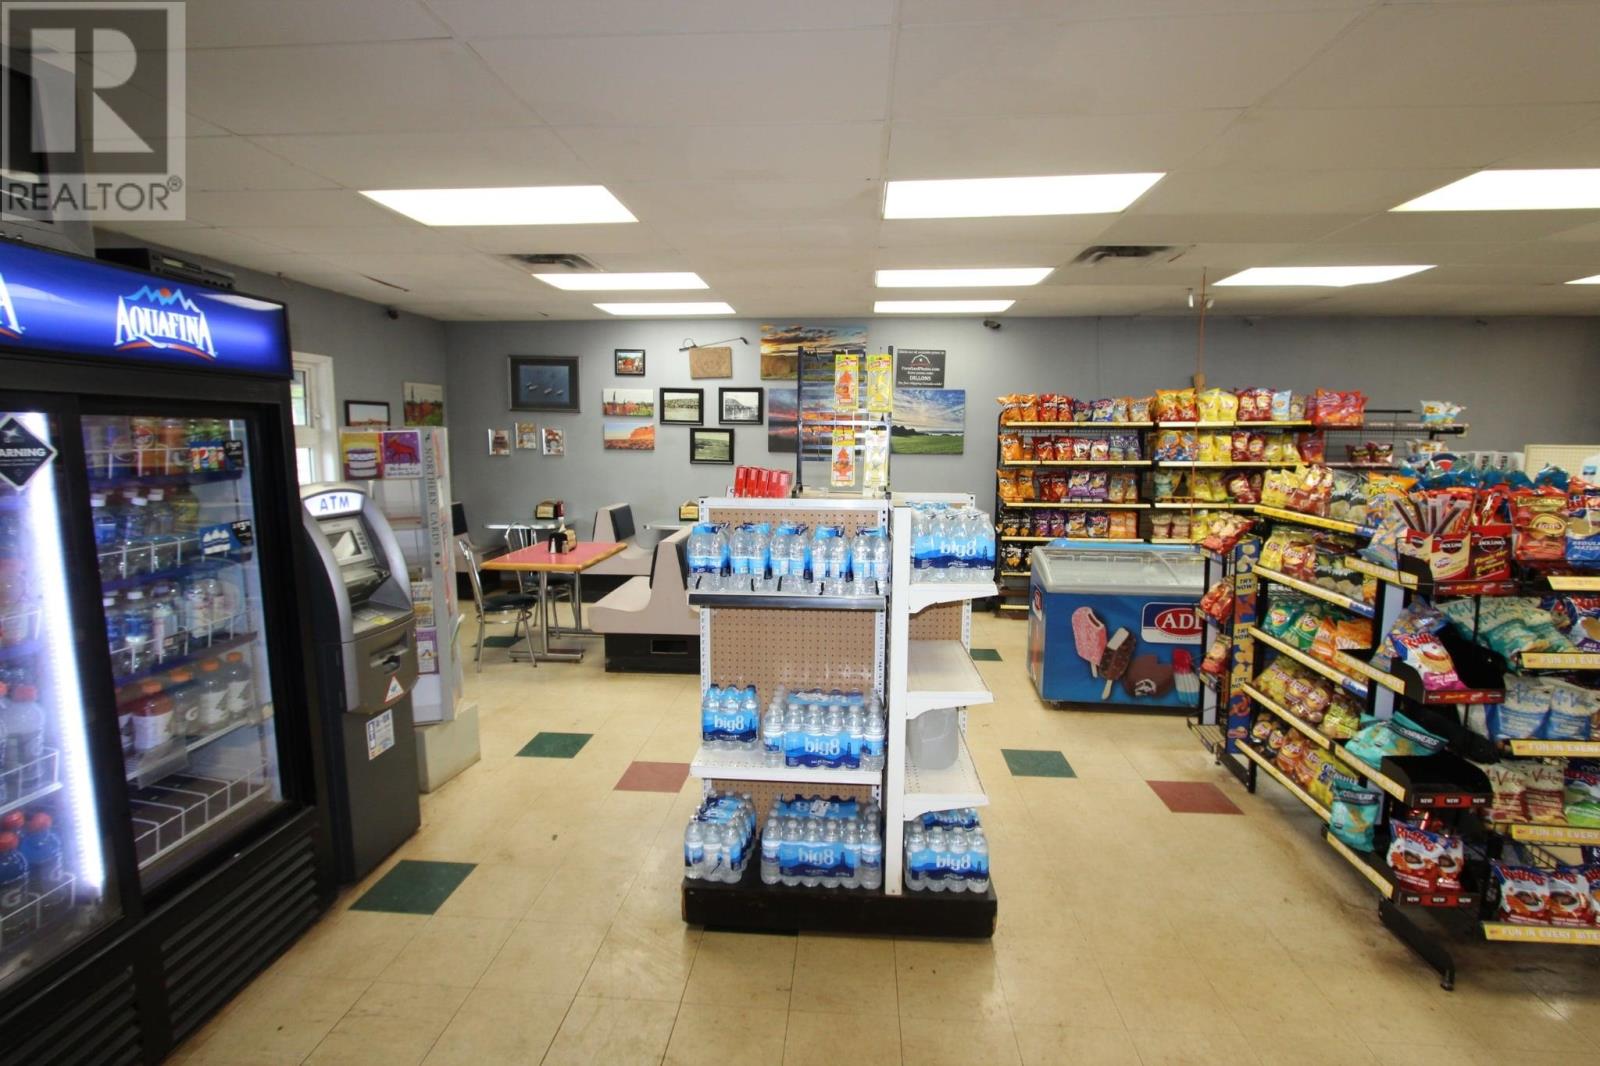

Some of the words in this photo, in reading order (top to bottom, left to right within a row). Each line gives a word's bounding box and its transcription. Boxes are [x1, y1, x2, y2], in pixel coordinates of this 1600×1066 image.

[113, 295, 217, 358] AQUAFINA
[0, 448, 47, 458] ARNING
[424, 447, 438, 505] NORTHERN
[319, 495, 351, 512] ATM
[941, 540, 977, 558] big8
[714, 714, 745, 732] big8
[804, 738, 840, 757] big8
[797, 847, 834, 866] big8
[936, 853, 971, 870] big8
